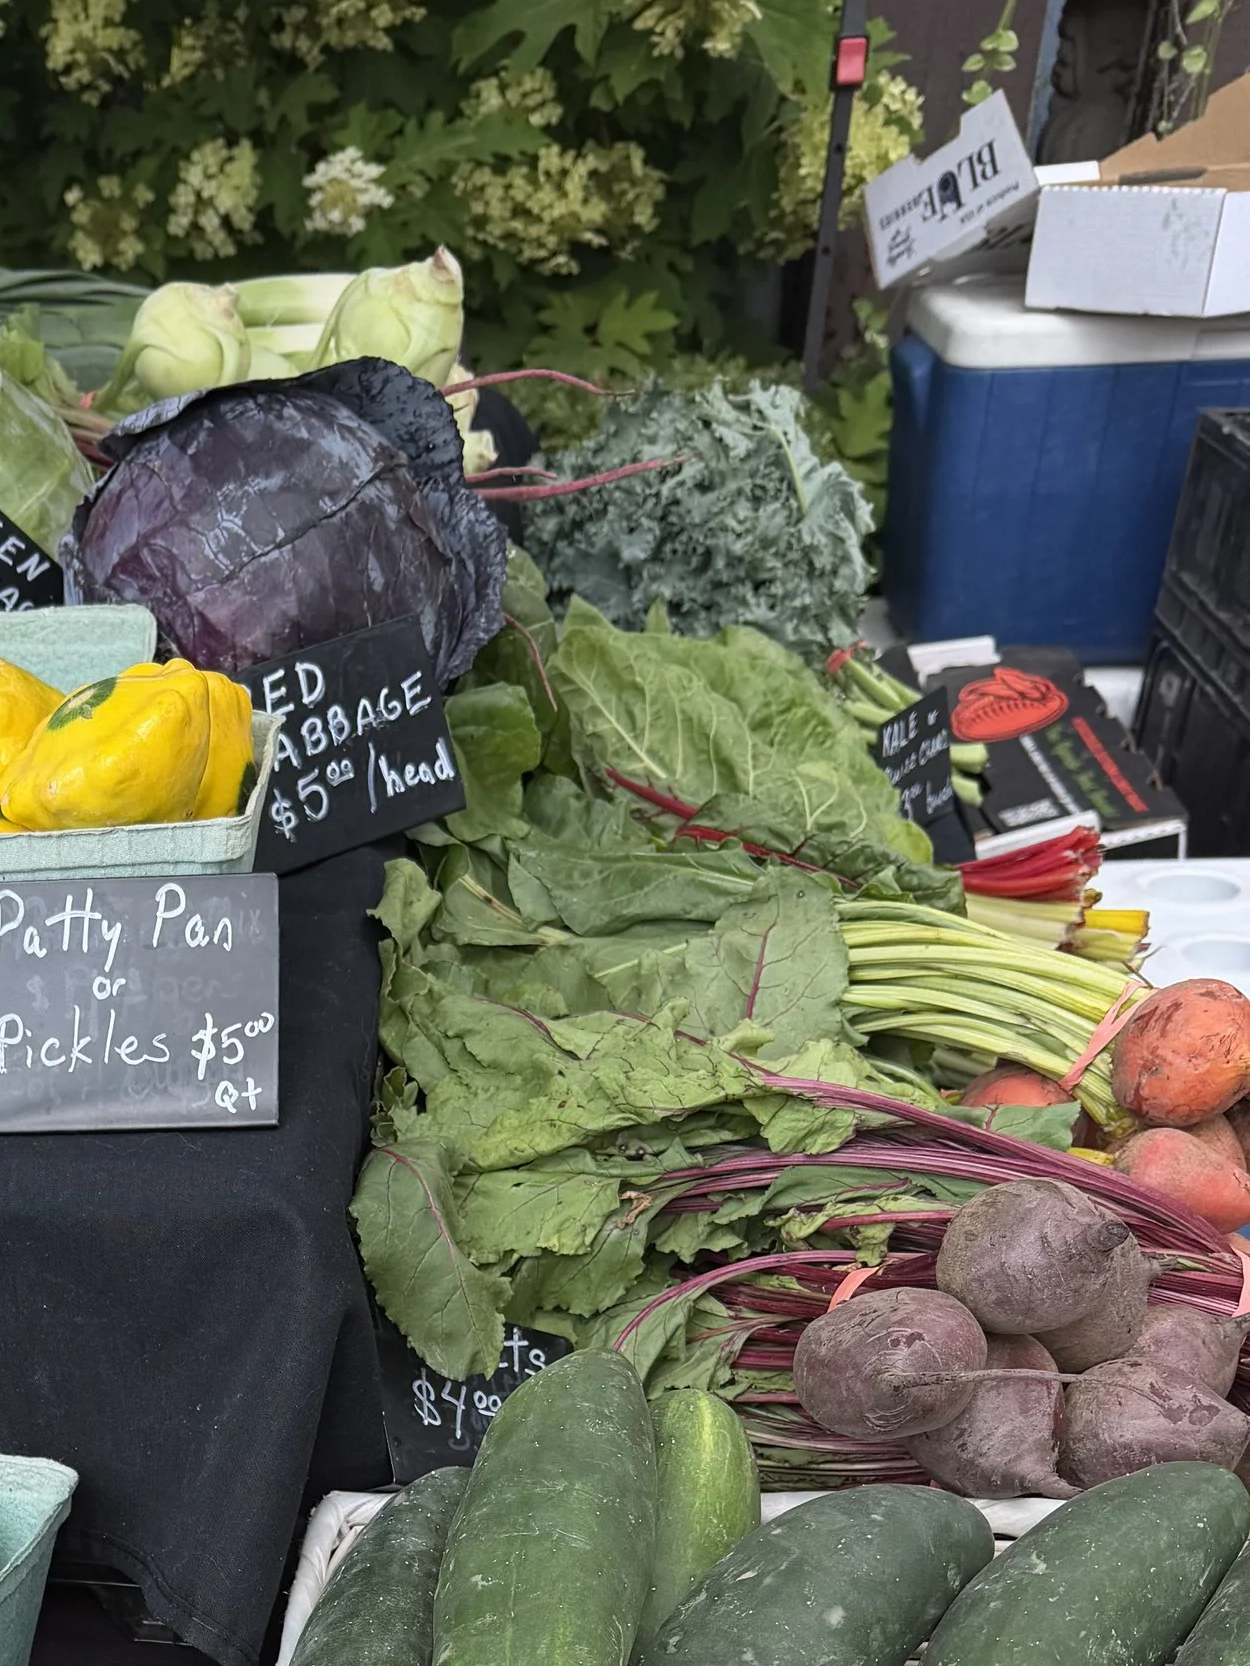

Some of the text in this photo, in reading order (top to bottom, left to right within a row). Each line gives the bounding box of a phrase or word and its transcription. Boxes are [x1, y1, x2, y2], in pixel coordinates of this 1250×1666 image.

[262, 662, 326, 715] ED
[273, 670, 433, 773] ABBAGE
[882, 710, 918, 759] KALE
[153, 882, 233, 952] Pan
[92, 976, 126, 1000] or
